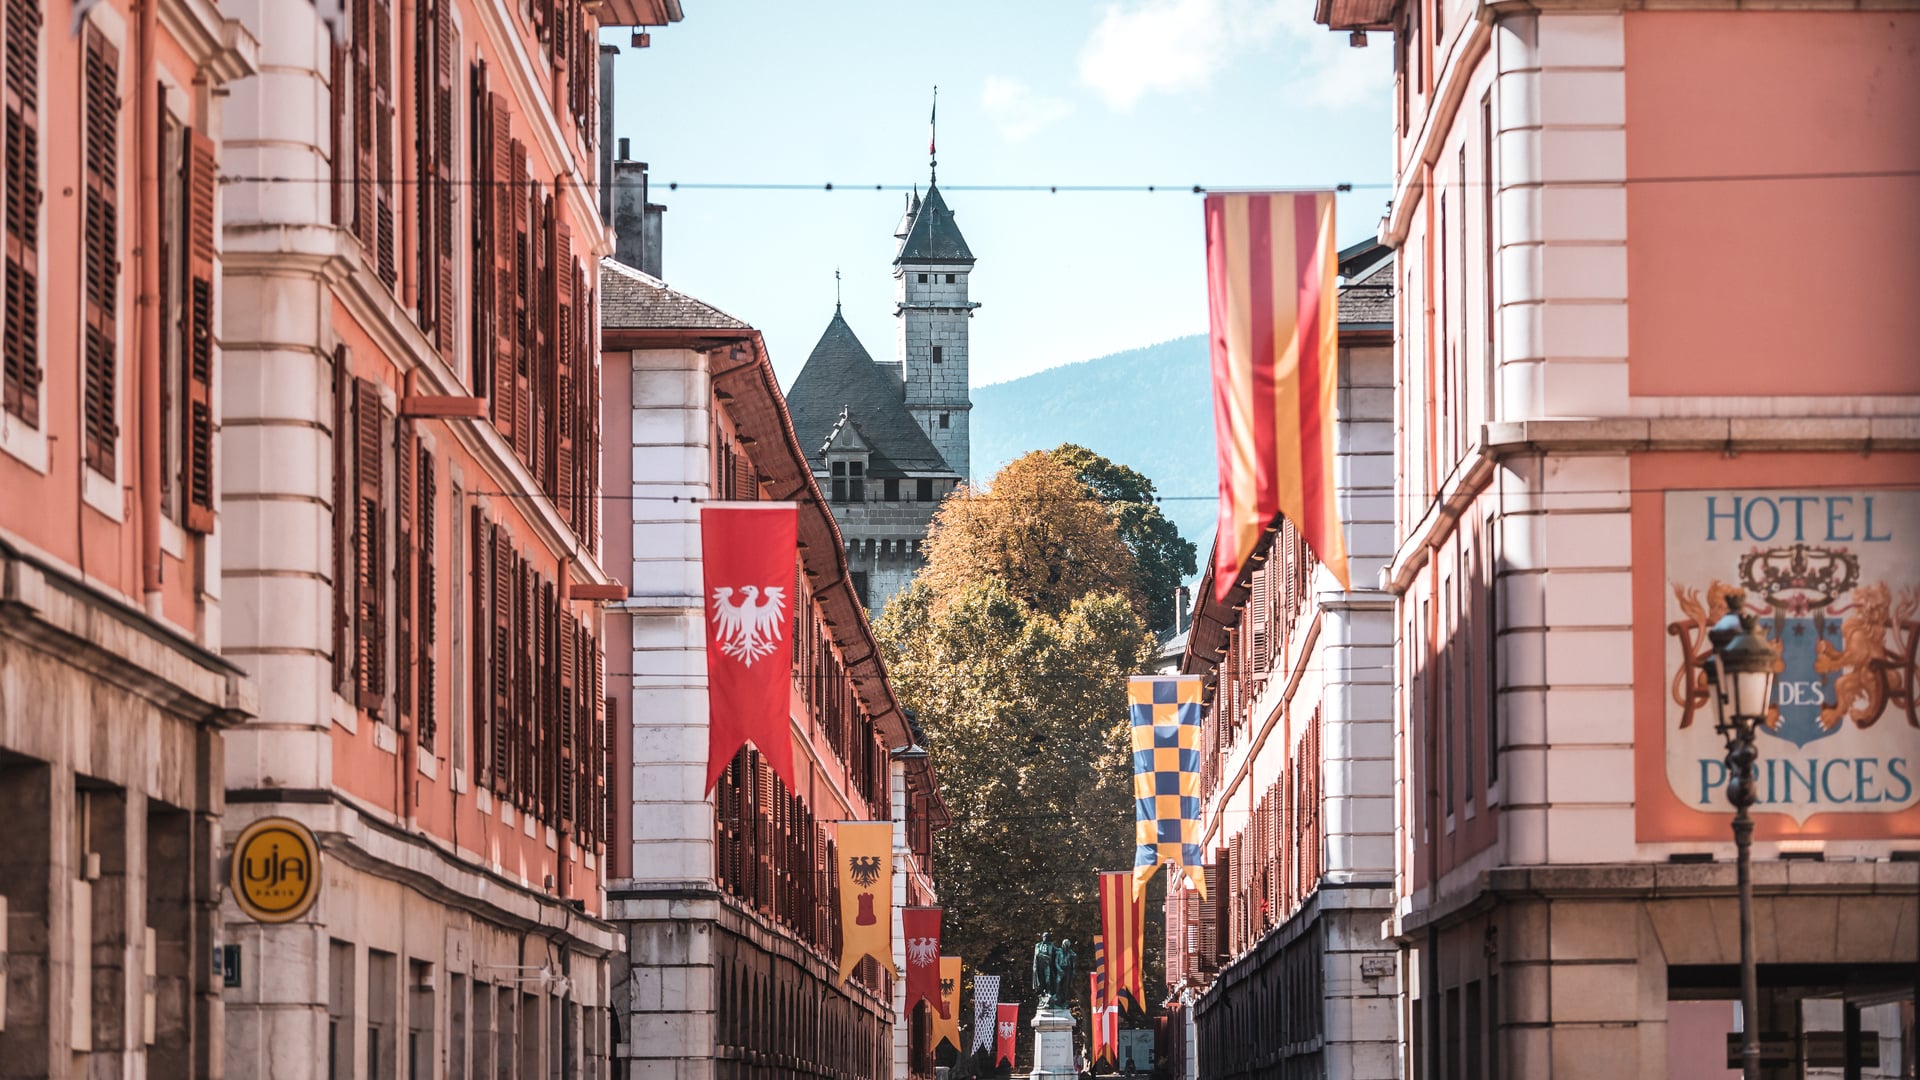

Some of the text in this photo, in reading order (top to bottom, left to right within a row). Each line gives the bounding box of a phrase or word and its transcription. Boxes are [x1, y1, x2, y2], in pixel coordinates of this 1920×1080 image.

[1706, 496, 1892, 542] HOTEL
[1778, 681, 1825, 706] DES
[1699, 757, 1912, 804] PINCES
[255, 889, 295, 897] PARIS
